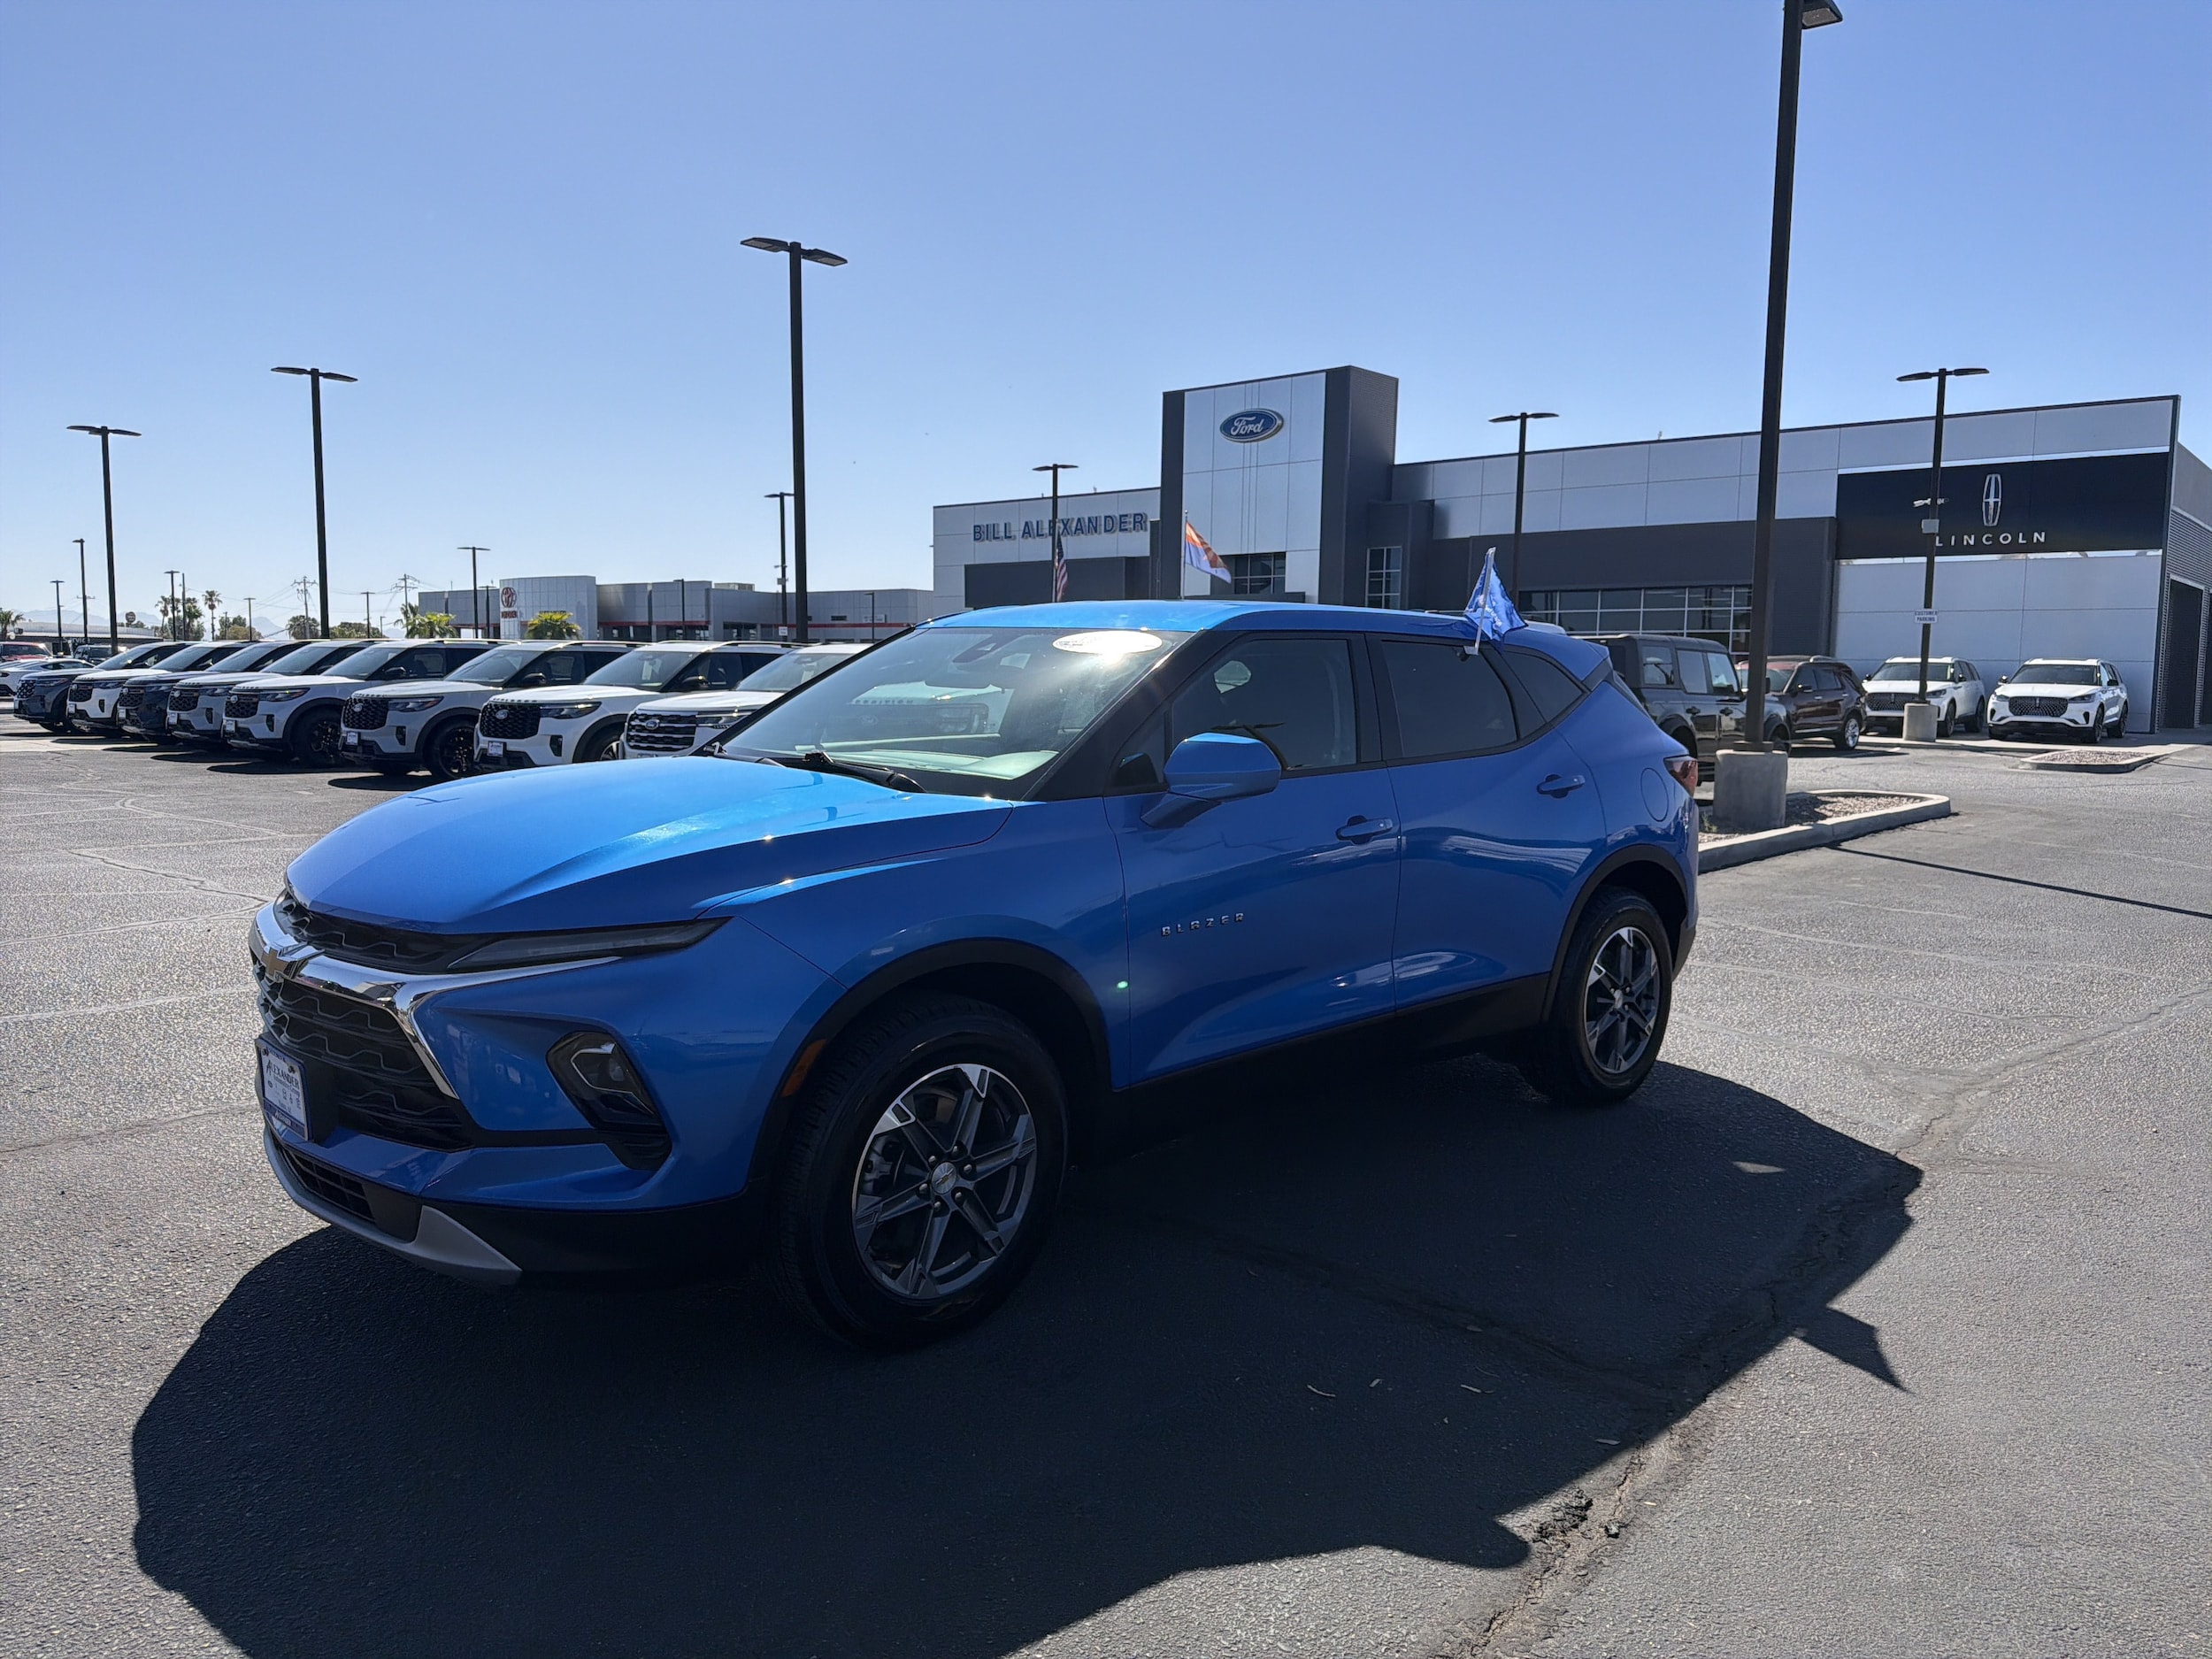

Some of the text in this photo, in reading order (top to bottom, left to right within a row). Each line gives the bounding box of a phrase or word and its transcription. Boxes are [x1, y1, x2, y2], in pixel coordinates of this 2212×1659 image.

[1230, 416, 1264, 435] Ford
[973, 522, 1014, 541] BILL
[1935, 531, 2046, 547] LINCOLN
[1161, 912, 1244, 936] BLAZER
